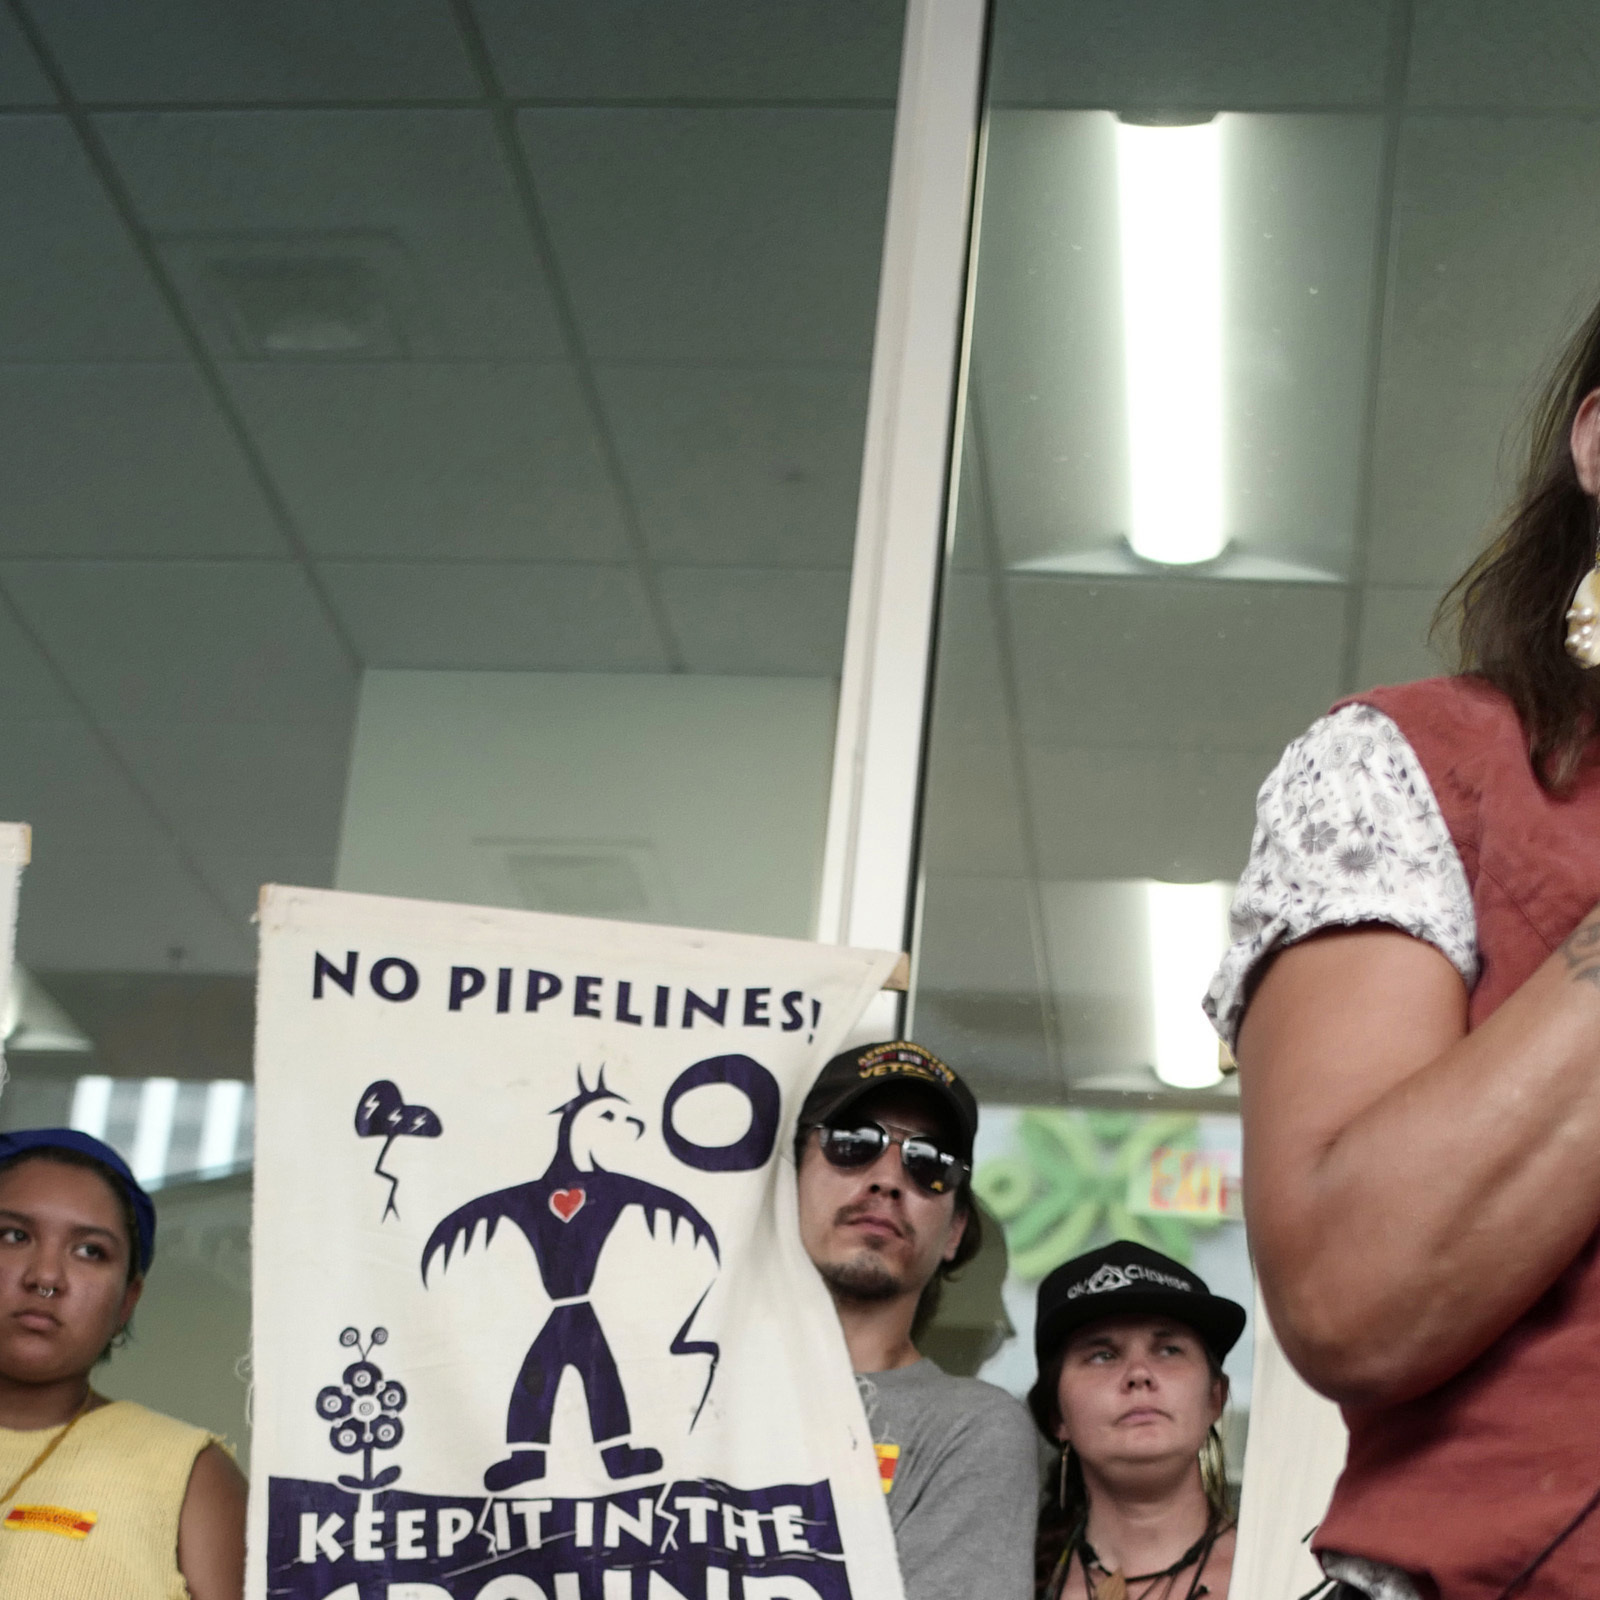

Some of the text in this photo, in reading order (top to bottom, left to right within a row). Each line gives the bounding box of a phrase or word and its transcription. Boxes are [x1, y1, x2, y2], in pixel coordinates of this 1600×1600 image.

[313, 950, 821, 1045] NO PIPELINES!
[300, 1497, 809, 1563] KEEP IT IN THE
